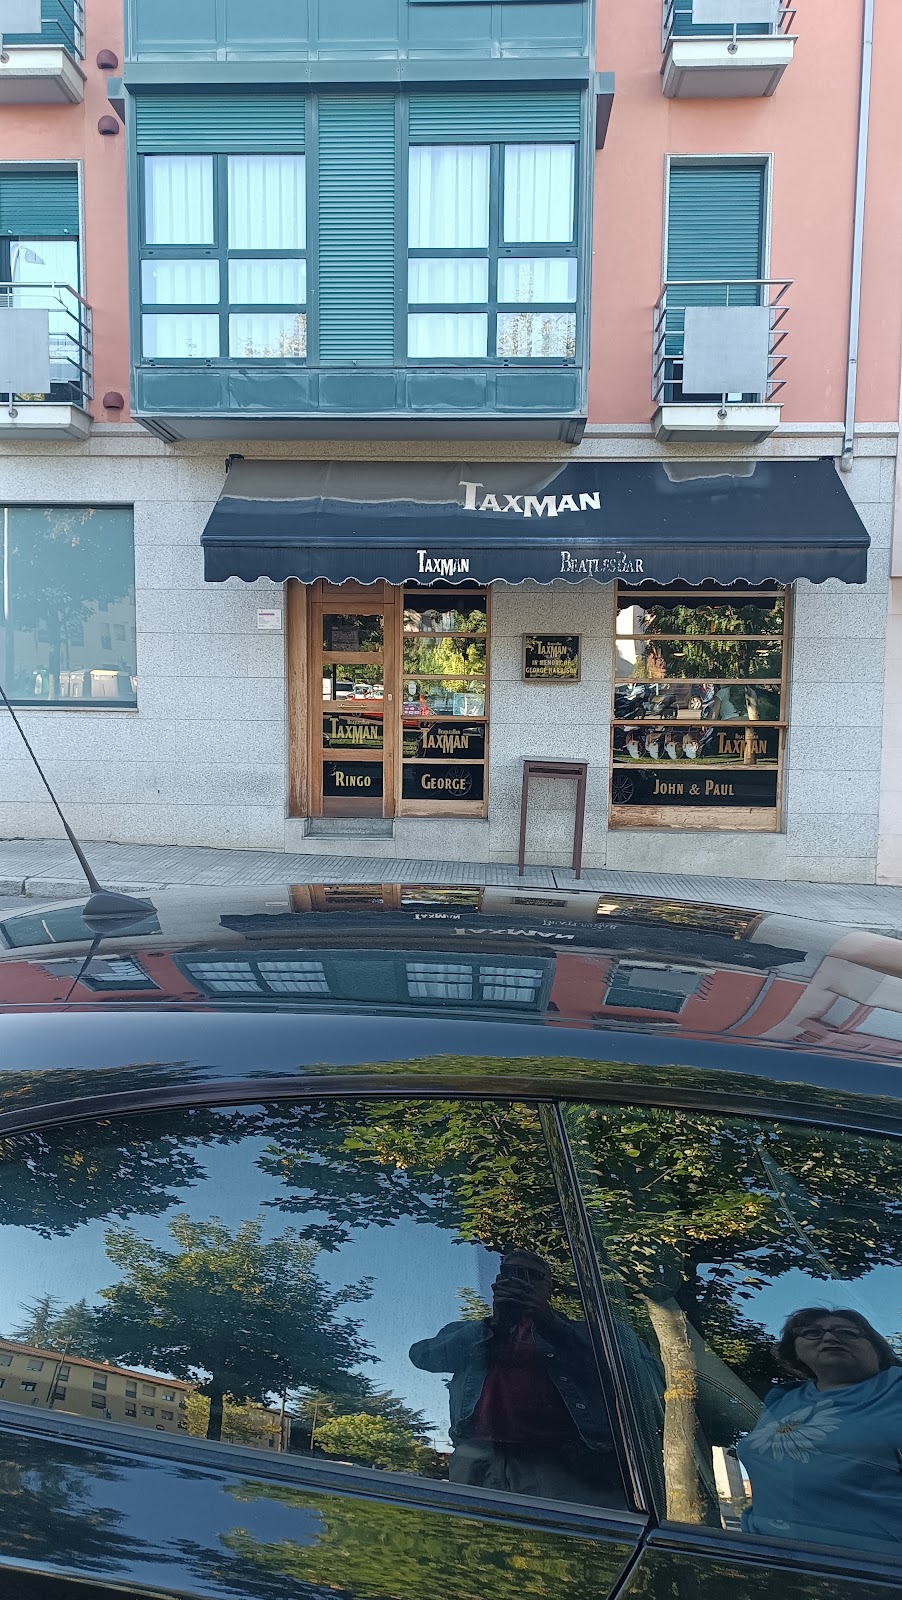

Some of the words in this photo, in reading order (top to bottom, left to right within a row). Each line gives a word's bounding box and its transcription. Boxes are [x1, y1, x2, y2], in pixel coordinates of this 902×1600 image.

[458, 481, 601, 517] TAXMAN
[416, 549, 470, 576] TAXMAN
[535, 640, 567, 658] TAXMAN
[329, 717, 378, 744] TAXMAN
[420, 727, 469, 754] TAXMAN
[335, 771, 372, 787] RINGO
[421, 773, 466, 790] GEORGE
[652, 779, 684, 795] JOHN
[688, 783, 700, 796] &
[704, 779, 735, 796] PAUL
